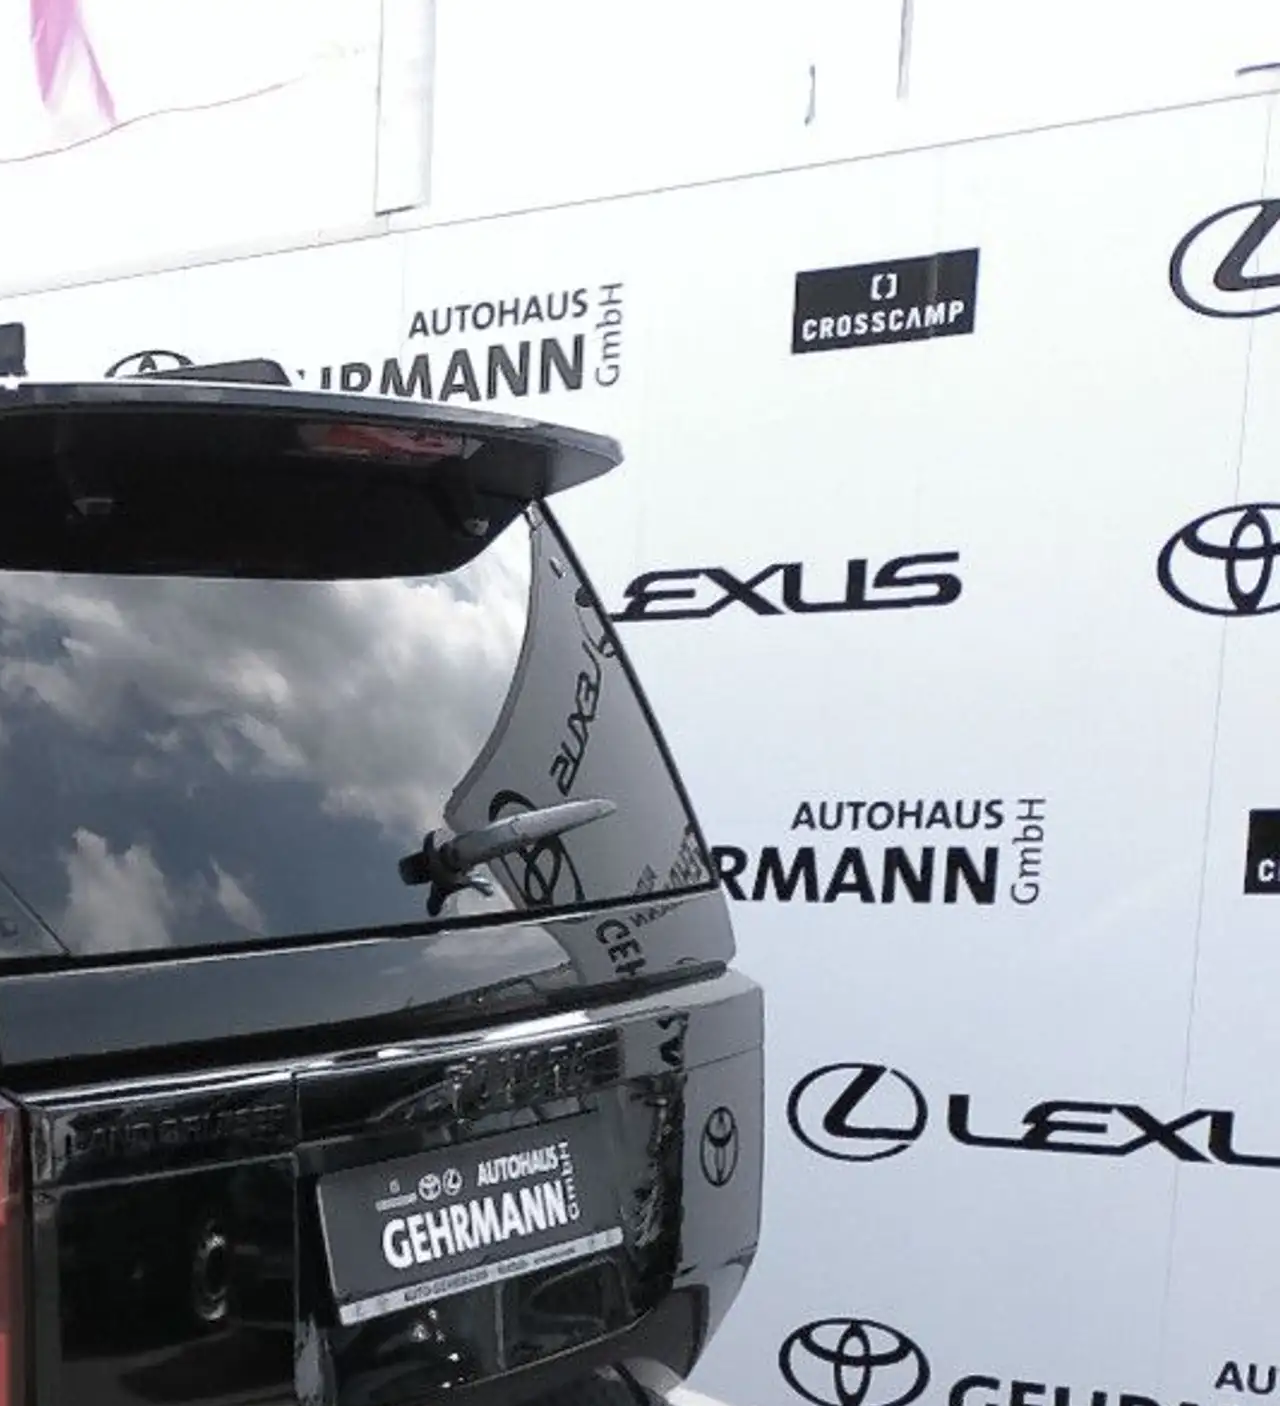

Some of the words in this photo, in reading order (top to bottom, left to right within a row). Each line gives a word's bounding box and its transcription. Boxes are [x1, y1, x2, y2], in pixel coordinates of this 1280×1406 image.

[408, 288, 588, 338] AUTOHAUS
[594, 282, 624, 388] GmbH
[802, 300, 965, 341] CROSSCAMP
[318, 333, 586, 403] RMANN
[610, 551, 963, 623] EXUS
[790, 799, 1004, 832] AUTOHAUS
[710, 845, 999, 905] RMANN
[1009, 798, 1047, 906] GmbH
[476, 1145, 559, 1187] AUTOHAUS
[947, 1093, 1280, 1169] LEXU
[382, 1180, 568, 1269] GEHRMANN
